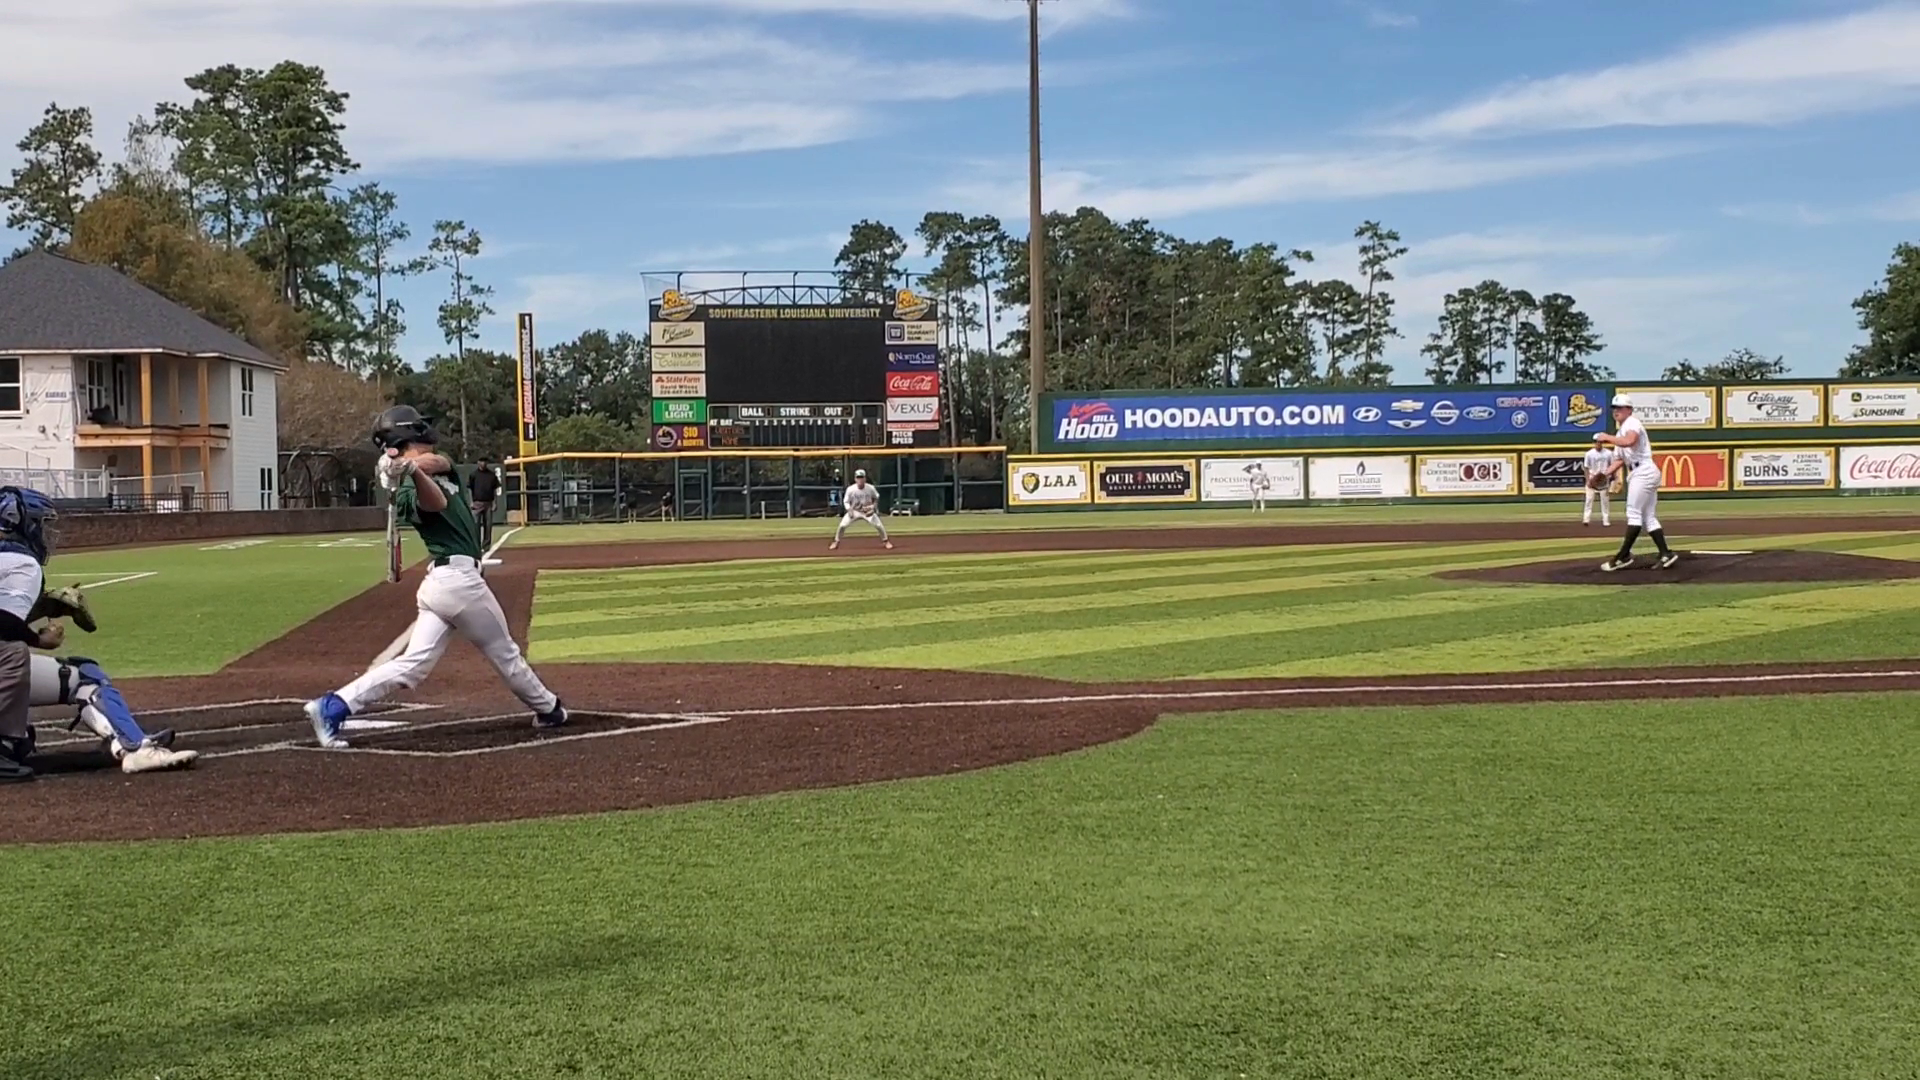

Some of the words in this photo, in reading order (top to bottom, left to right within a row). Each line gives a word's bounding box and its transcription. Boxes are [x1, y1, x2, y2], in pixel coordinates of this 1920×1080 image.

[708, 308, 777, 319] SOUTHEASTERN
[780, 308, 826, 318] LOUISIANA
[828, 308, 881, 318] UNIVERSITY
[1496, 396, 1543, 407] GMC
[741, 407, 764, 417] BALL
[780, 407, 810, 417] STRIKE
[824, 407, 843, 416] OUT
[889, 401, 933, 414] VEXUS
[1859, 408, 1905, 417] SUNSHINE
[664, 411, 694, 419] LIGHT
[1092, 414, 1116, 422] BILL
[1124, 405, 1345, 429] HOODAUTO.COM
[1058, 418, 1119, 440] HOOD
[1744, 465, 1788, 477] BURNS
[1850, 453, 1920, 480] Coca-Cola
[1043, 475, 1077, 487] LAA
[1106, 473, 1134, 484] OUR
[1145, 471, 1184, 483] MOM'S
[1338, 476, 1381, 484] Louisiana
